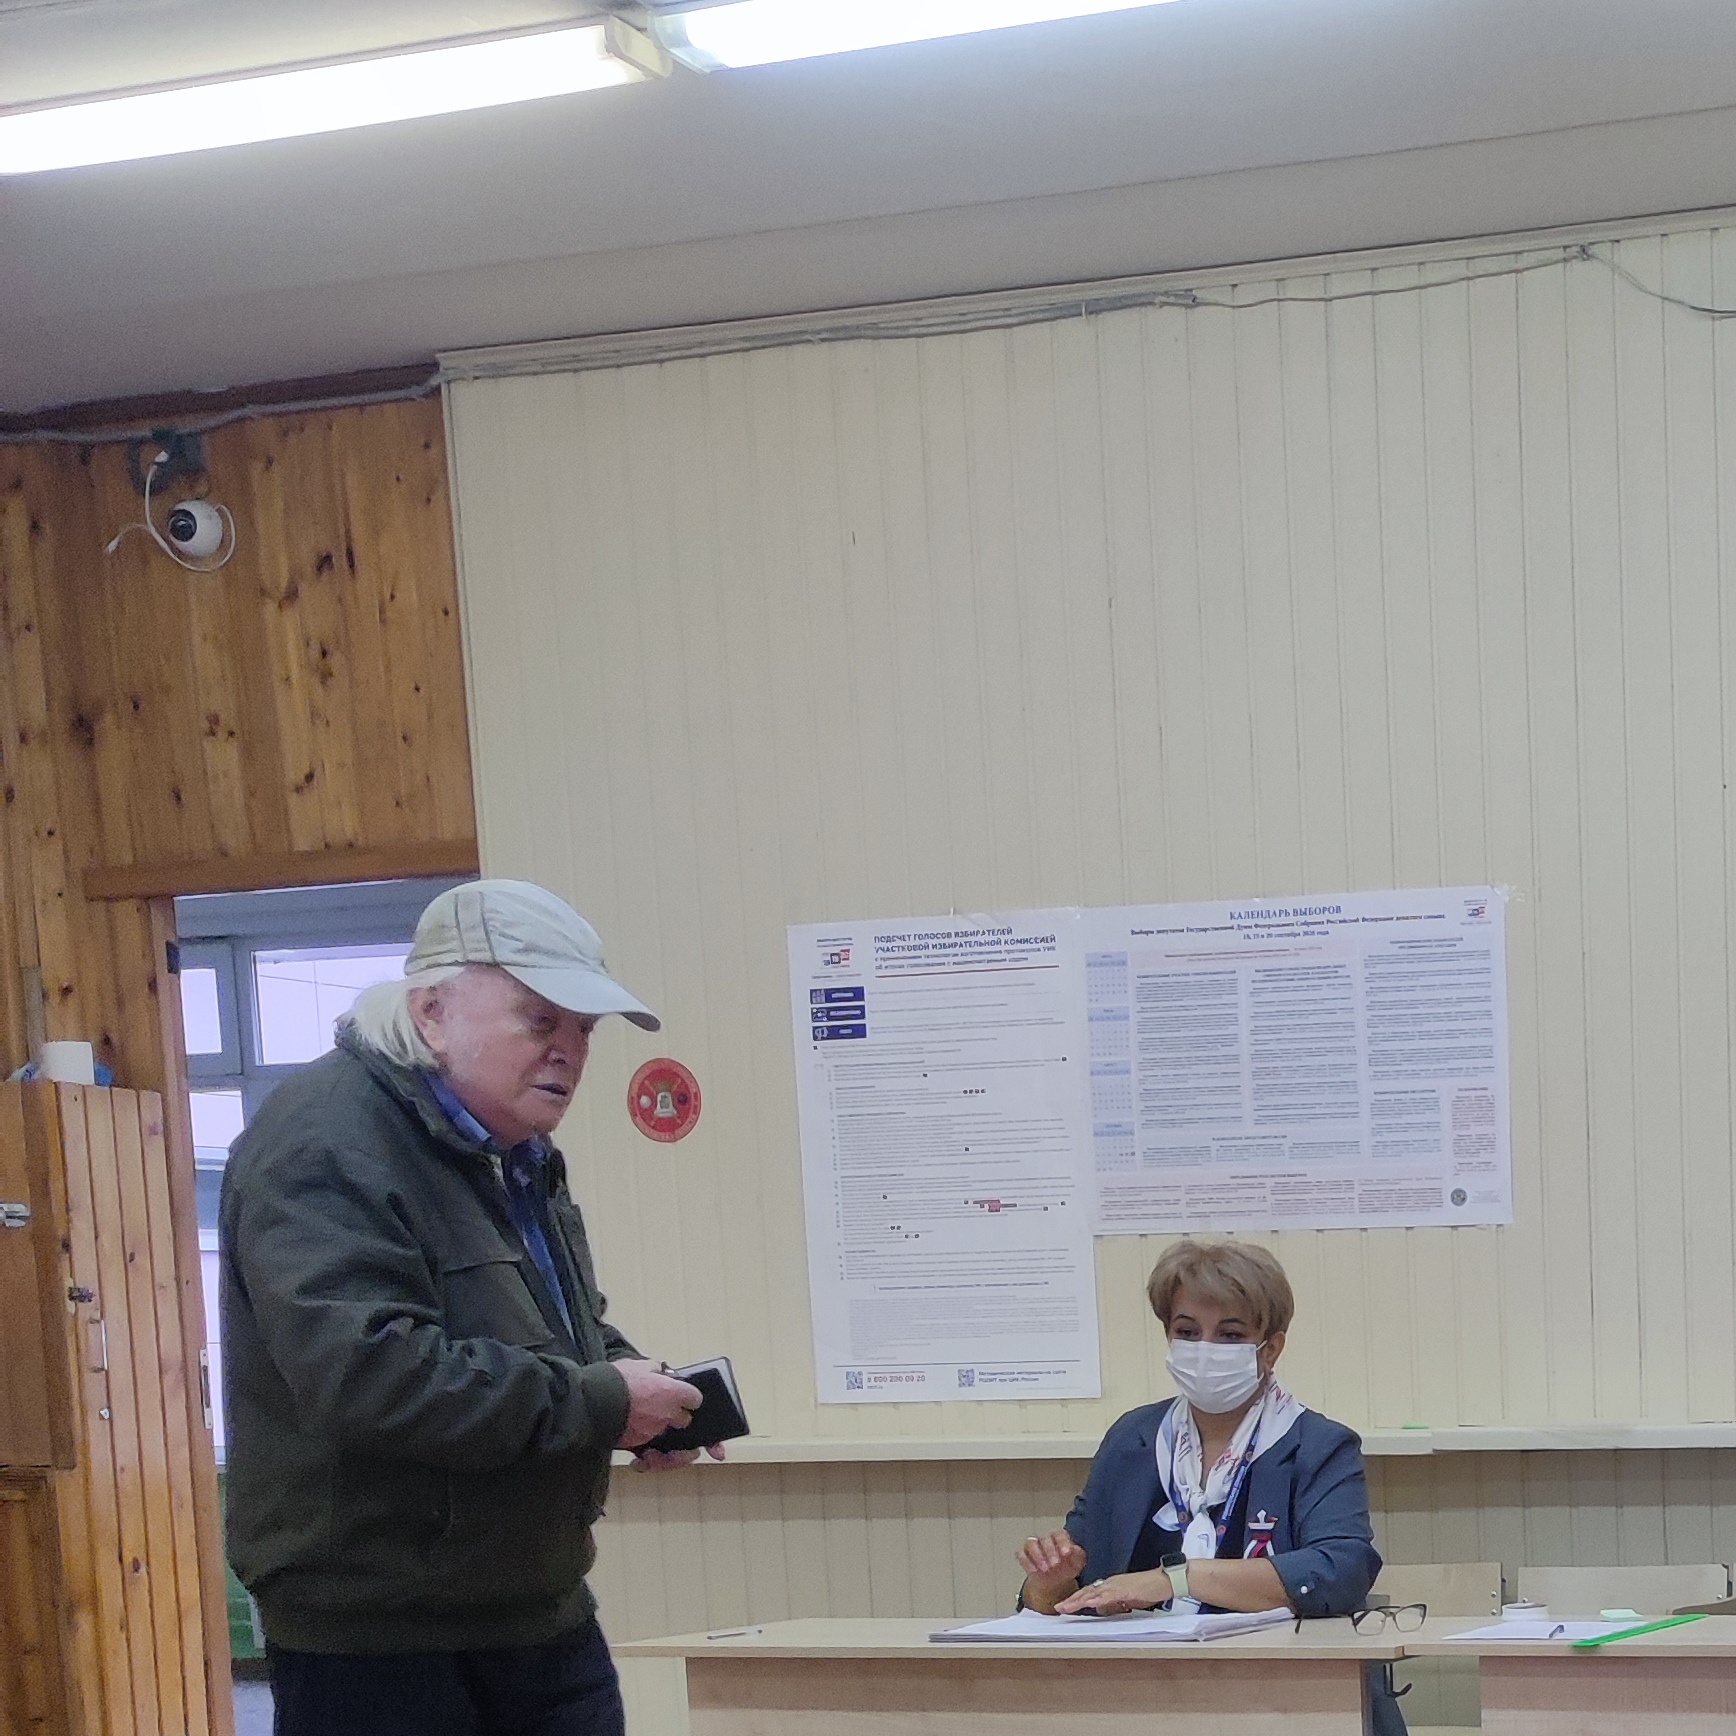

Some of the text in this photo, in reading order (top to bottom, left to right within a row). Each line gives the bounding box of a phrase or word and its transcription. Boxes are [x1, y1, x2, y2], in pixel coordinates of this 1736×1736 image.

[1230, 905, 1341, 921] КАЛЕНДАРЬ ВЫБОРОВ
[874, 926, 1012, 944] ПОДСЧЕТ ГОЛОСОВ ИЗБИРАТЕЛЕЙ
[874, 934, 1056, 954] УЧАСТКОВОЙ ИЗБИРАТЕЛЬНОЙ КОМИССИЕЙ
